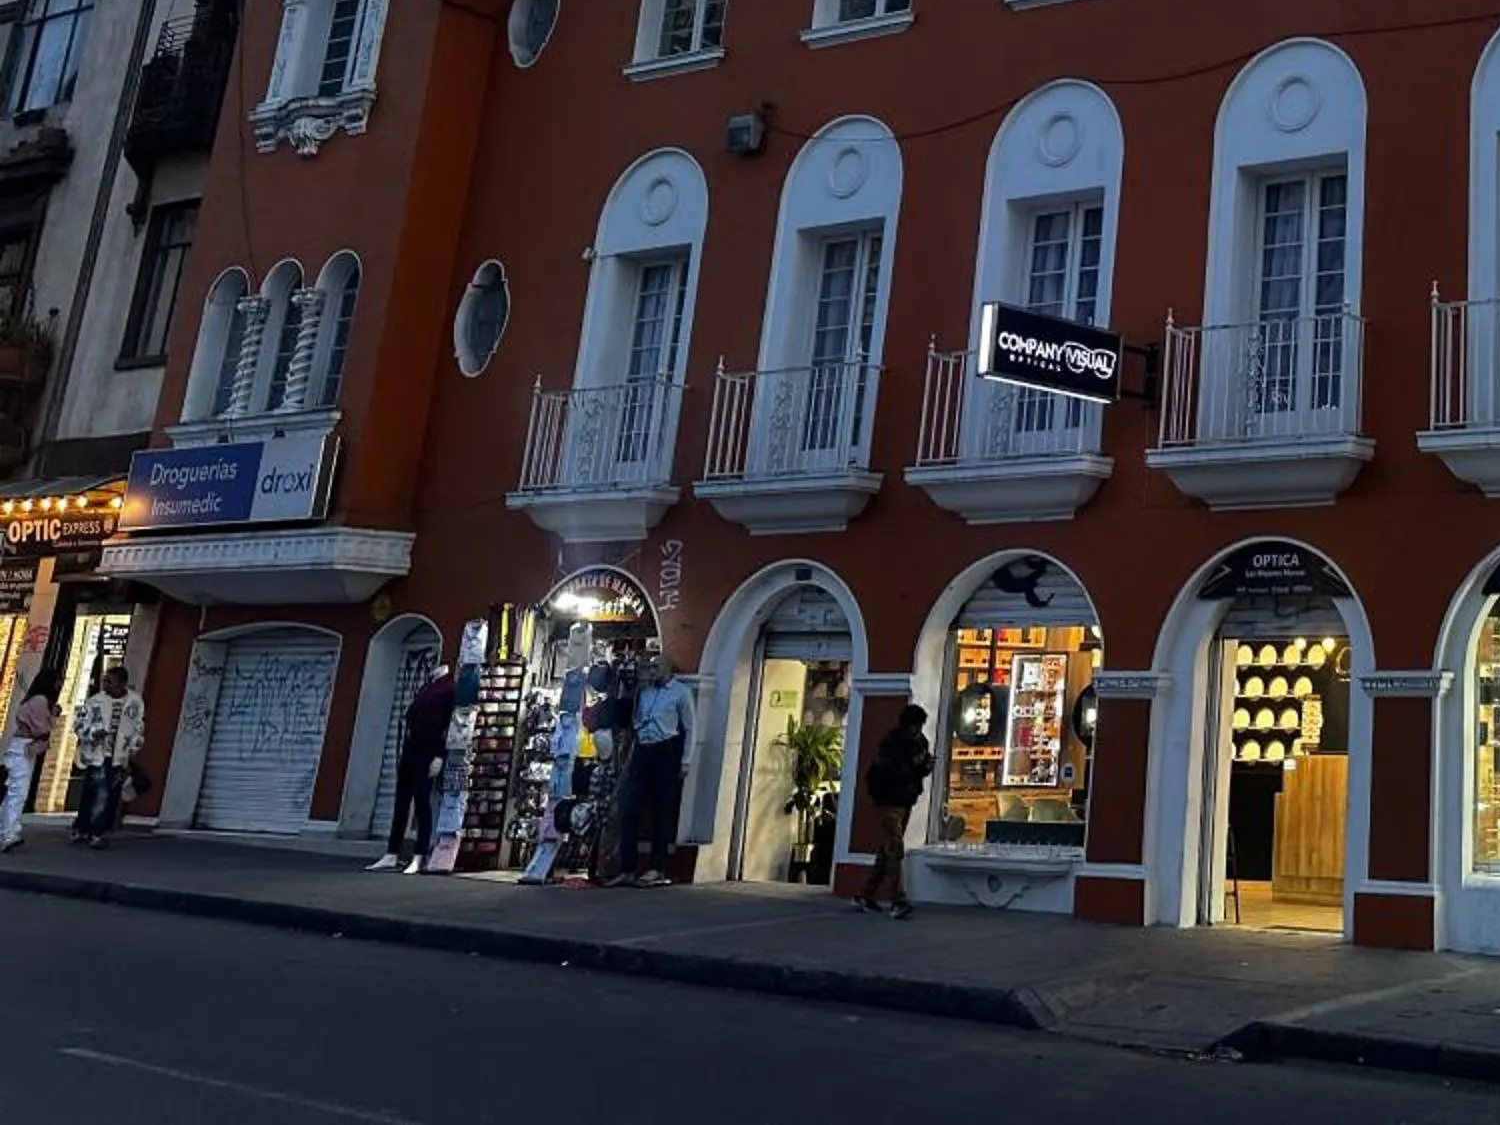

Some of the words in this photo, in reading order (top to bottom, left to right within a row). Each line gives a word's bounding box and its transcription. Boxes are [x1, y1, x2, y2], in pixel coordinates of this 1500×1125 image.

[998, 331, 1065, 362] COMPANY
[1065, 344, 1114, 376] VISUAL
[150, 458, 239, 490] Droguerías
[150, 492, 223, 517] Insumedic
[8, 518, 61, 544] OPTIC
[62, 520, 101, 536] EXPRESS
